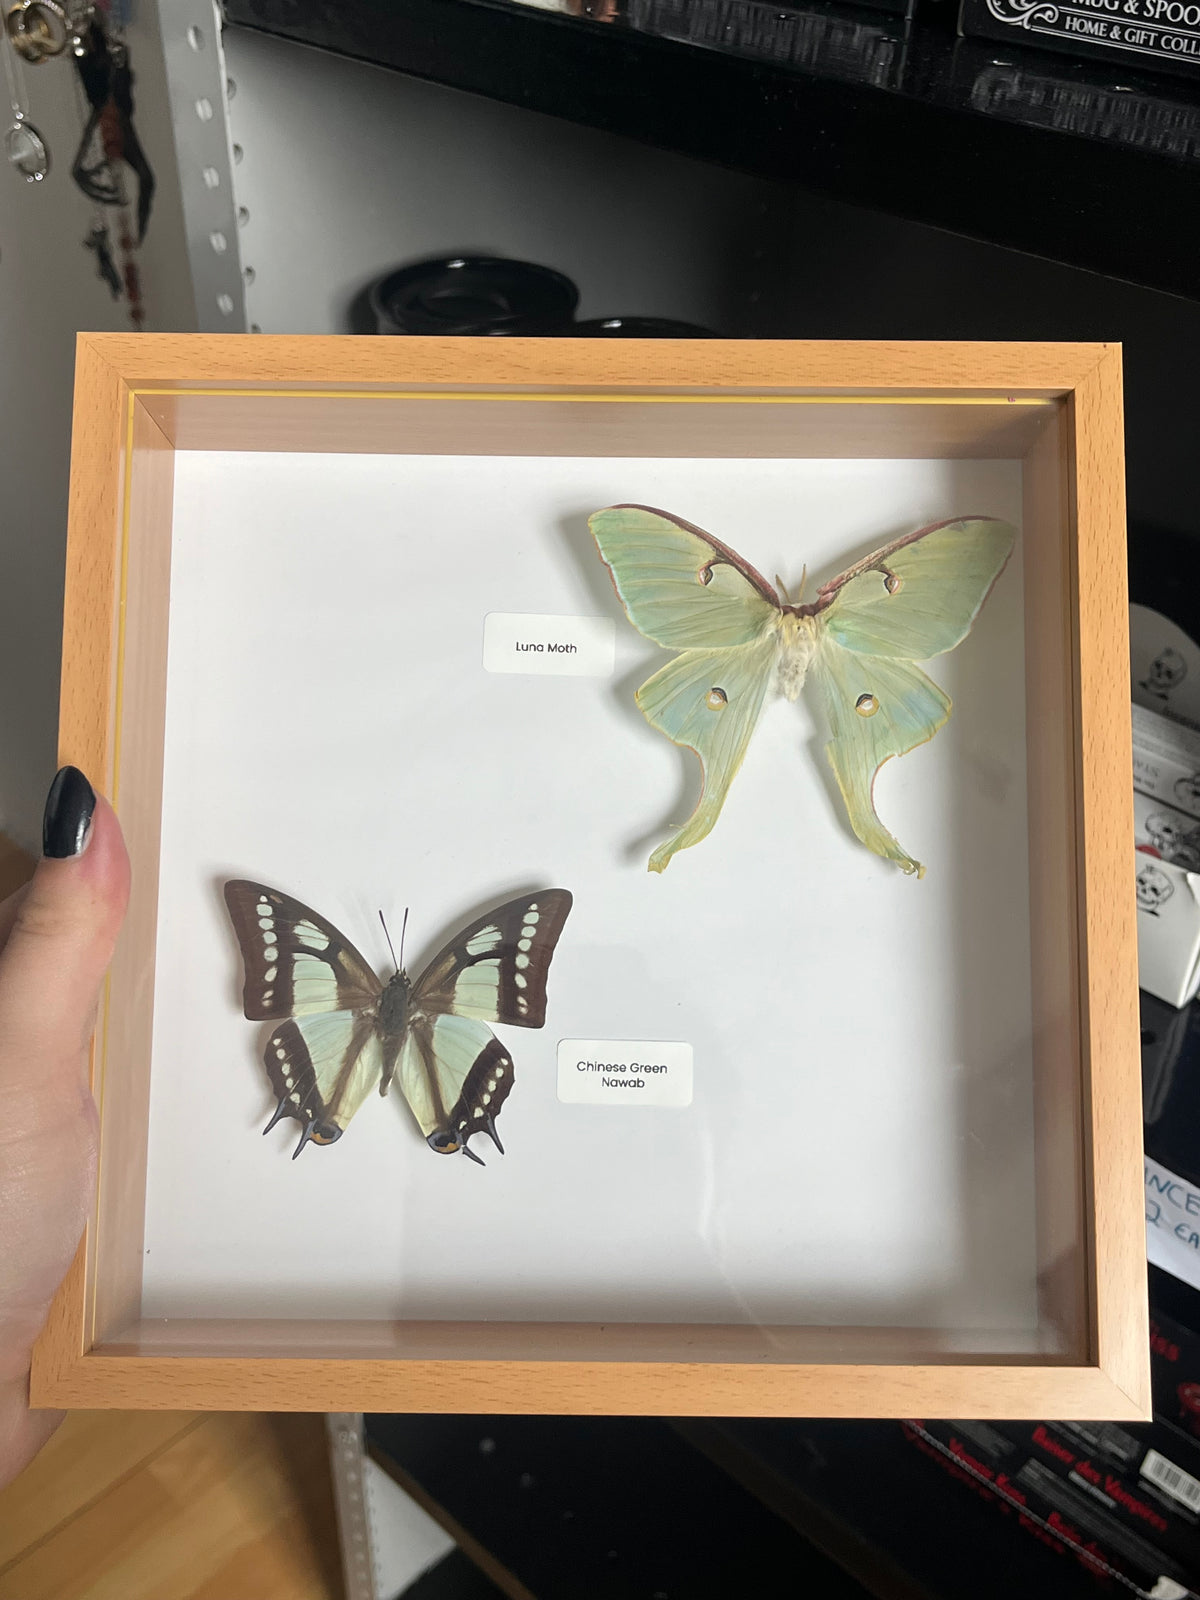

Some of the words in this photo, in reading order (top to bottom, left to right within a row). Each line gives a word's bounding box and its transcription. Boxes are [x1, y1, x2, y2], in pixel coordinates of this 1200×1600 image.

[1143, 0, 1200, 26] SPOO
[1065, 16, 1108, 37] HOME
[1109, 25, 1121, 40] &
[1124, 27, 1158, 46] GIFT
[1161, 35, 1200, 55] COLL
[516, 642, 544, 652] Luna
[548, 643, 577, 653] Moth
[577, 1061, 626, 1072] Chinese
[630, 1063, 667, 1073] Green
[602, 1077, 645, 1088] Nawab
